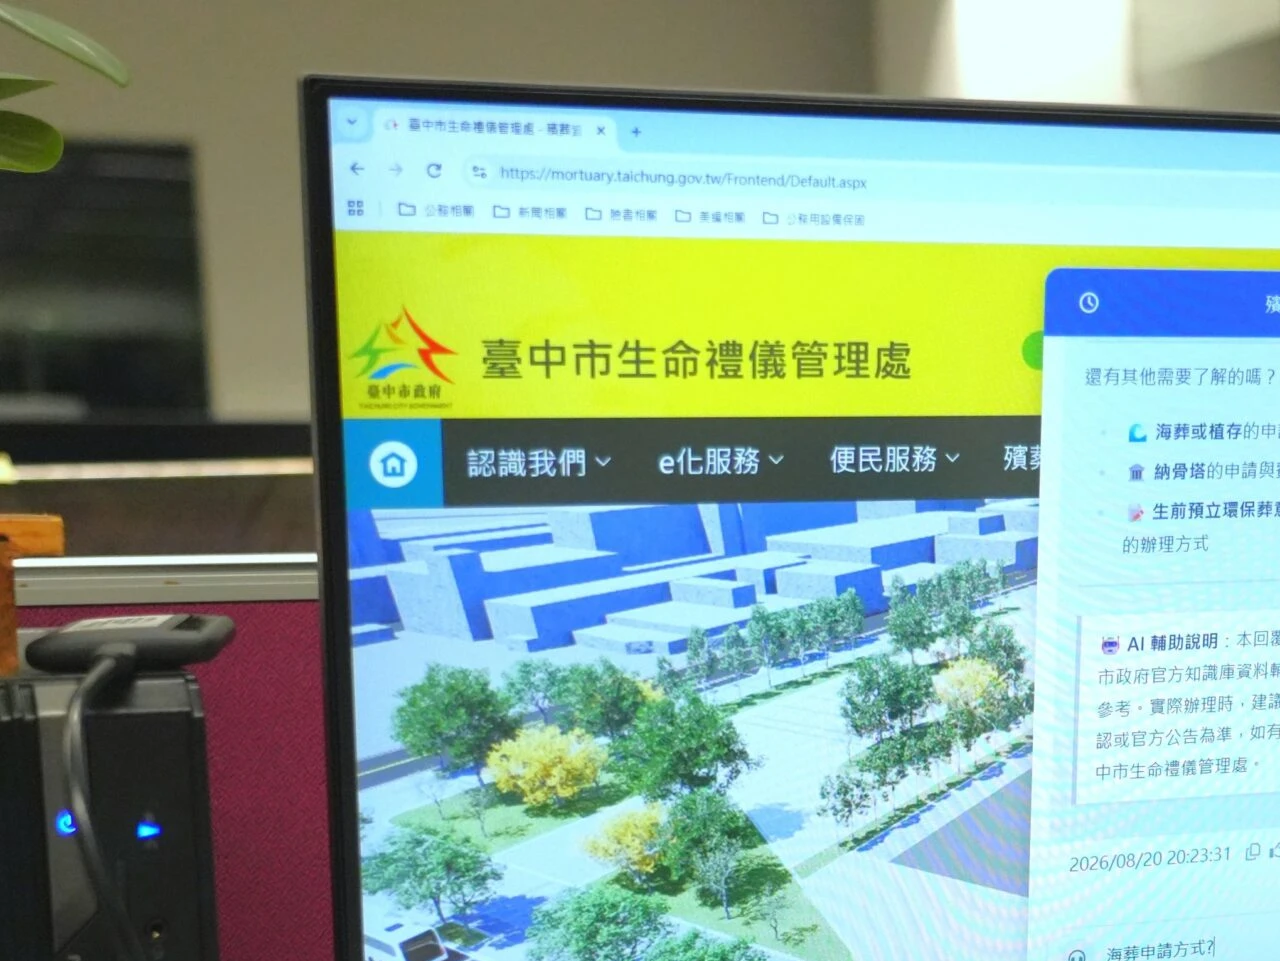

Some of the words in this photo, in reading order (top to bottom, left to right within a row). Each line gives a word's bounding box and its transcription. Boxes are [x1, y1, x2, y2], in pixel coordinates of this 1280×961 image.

[500, 166, 867, 190] https://mortuary.taichung.gov.tw/Frontend/Default.aspx
[480, 338, 912, 381] 臺中市生命禮儀管理處
[466, 448, 587, 478] 認識我們
[658, 447, 760, 475] e化服務
[830, 446, 938, 473] 便民服務
[1122, 534, 1210, 555] 的辦理方式
[1127, 637, 1145, 652] AI
[1069, 851, 1163, 872] 2026/08/20
[1167, 846, 1230, 865] 20:23:31
